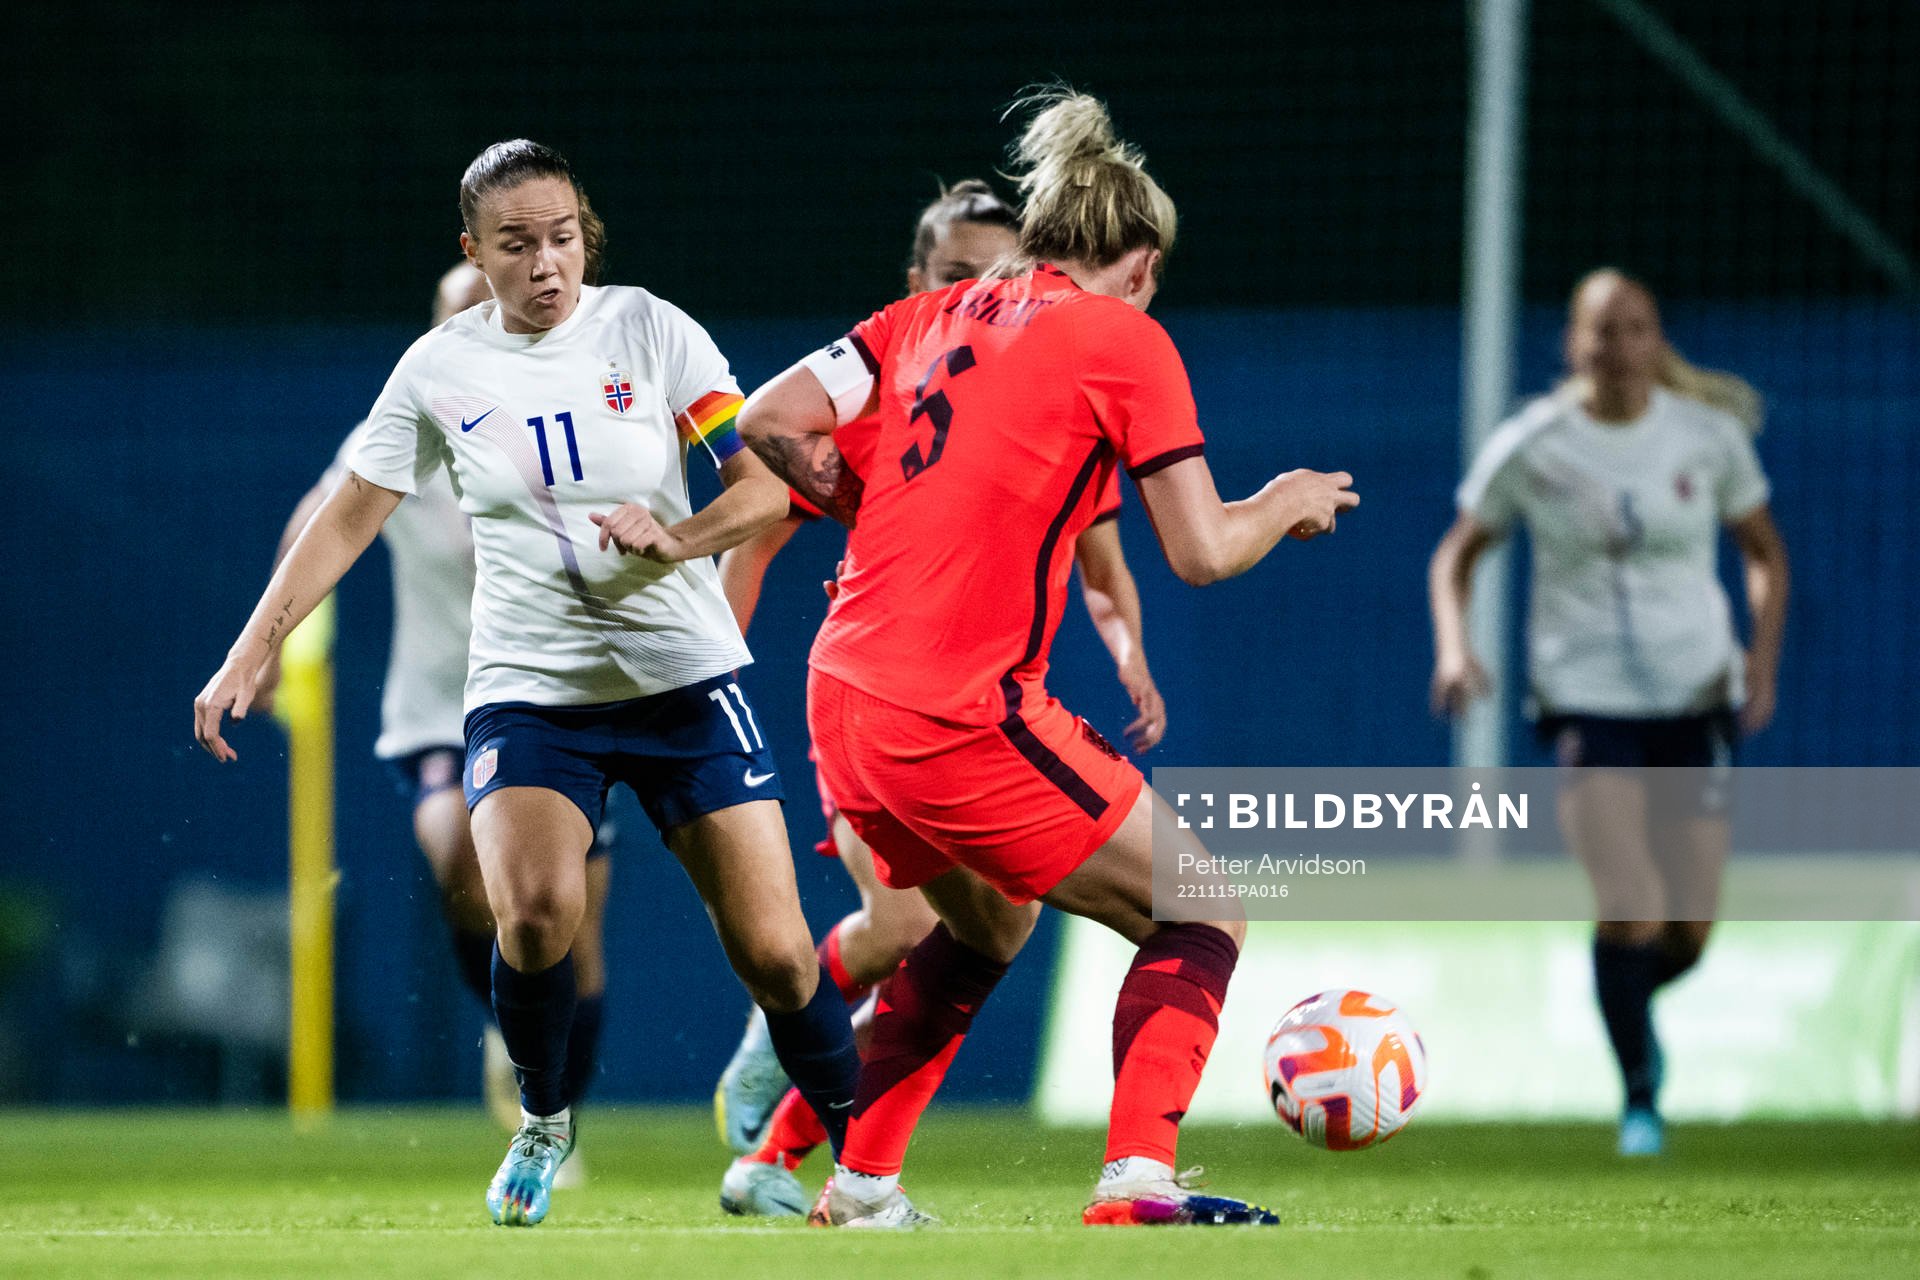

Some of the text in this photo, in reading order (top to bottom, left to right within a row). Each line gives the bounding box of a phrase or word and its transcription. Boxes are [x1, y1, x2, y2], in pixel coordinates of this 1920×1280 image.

[527, 411, 584, 487] 11
[900, 345, 977, 482] 5
[707, 683, 764, 753] 11
